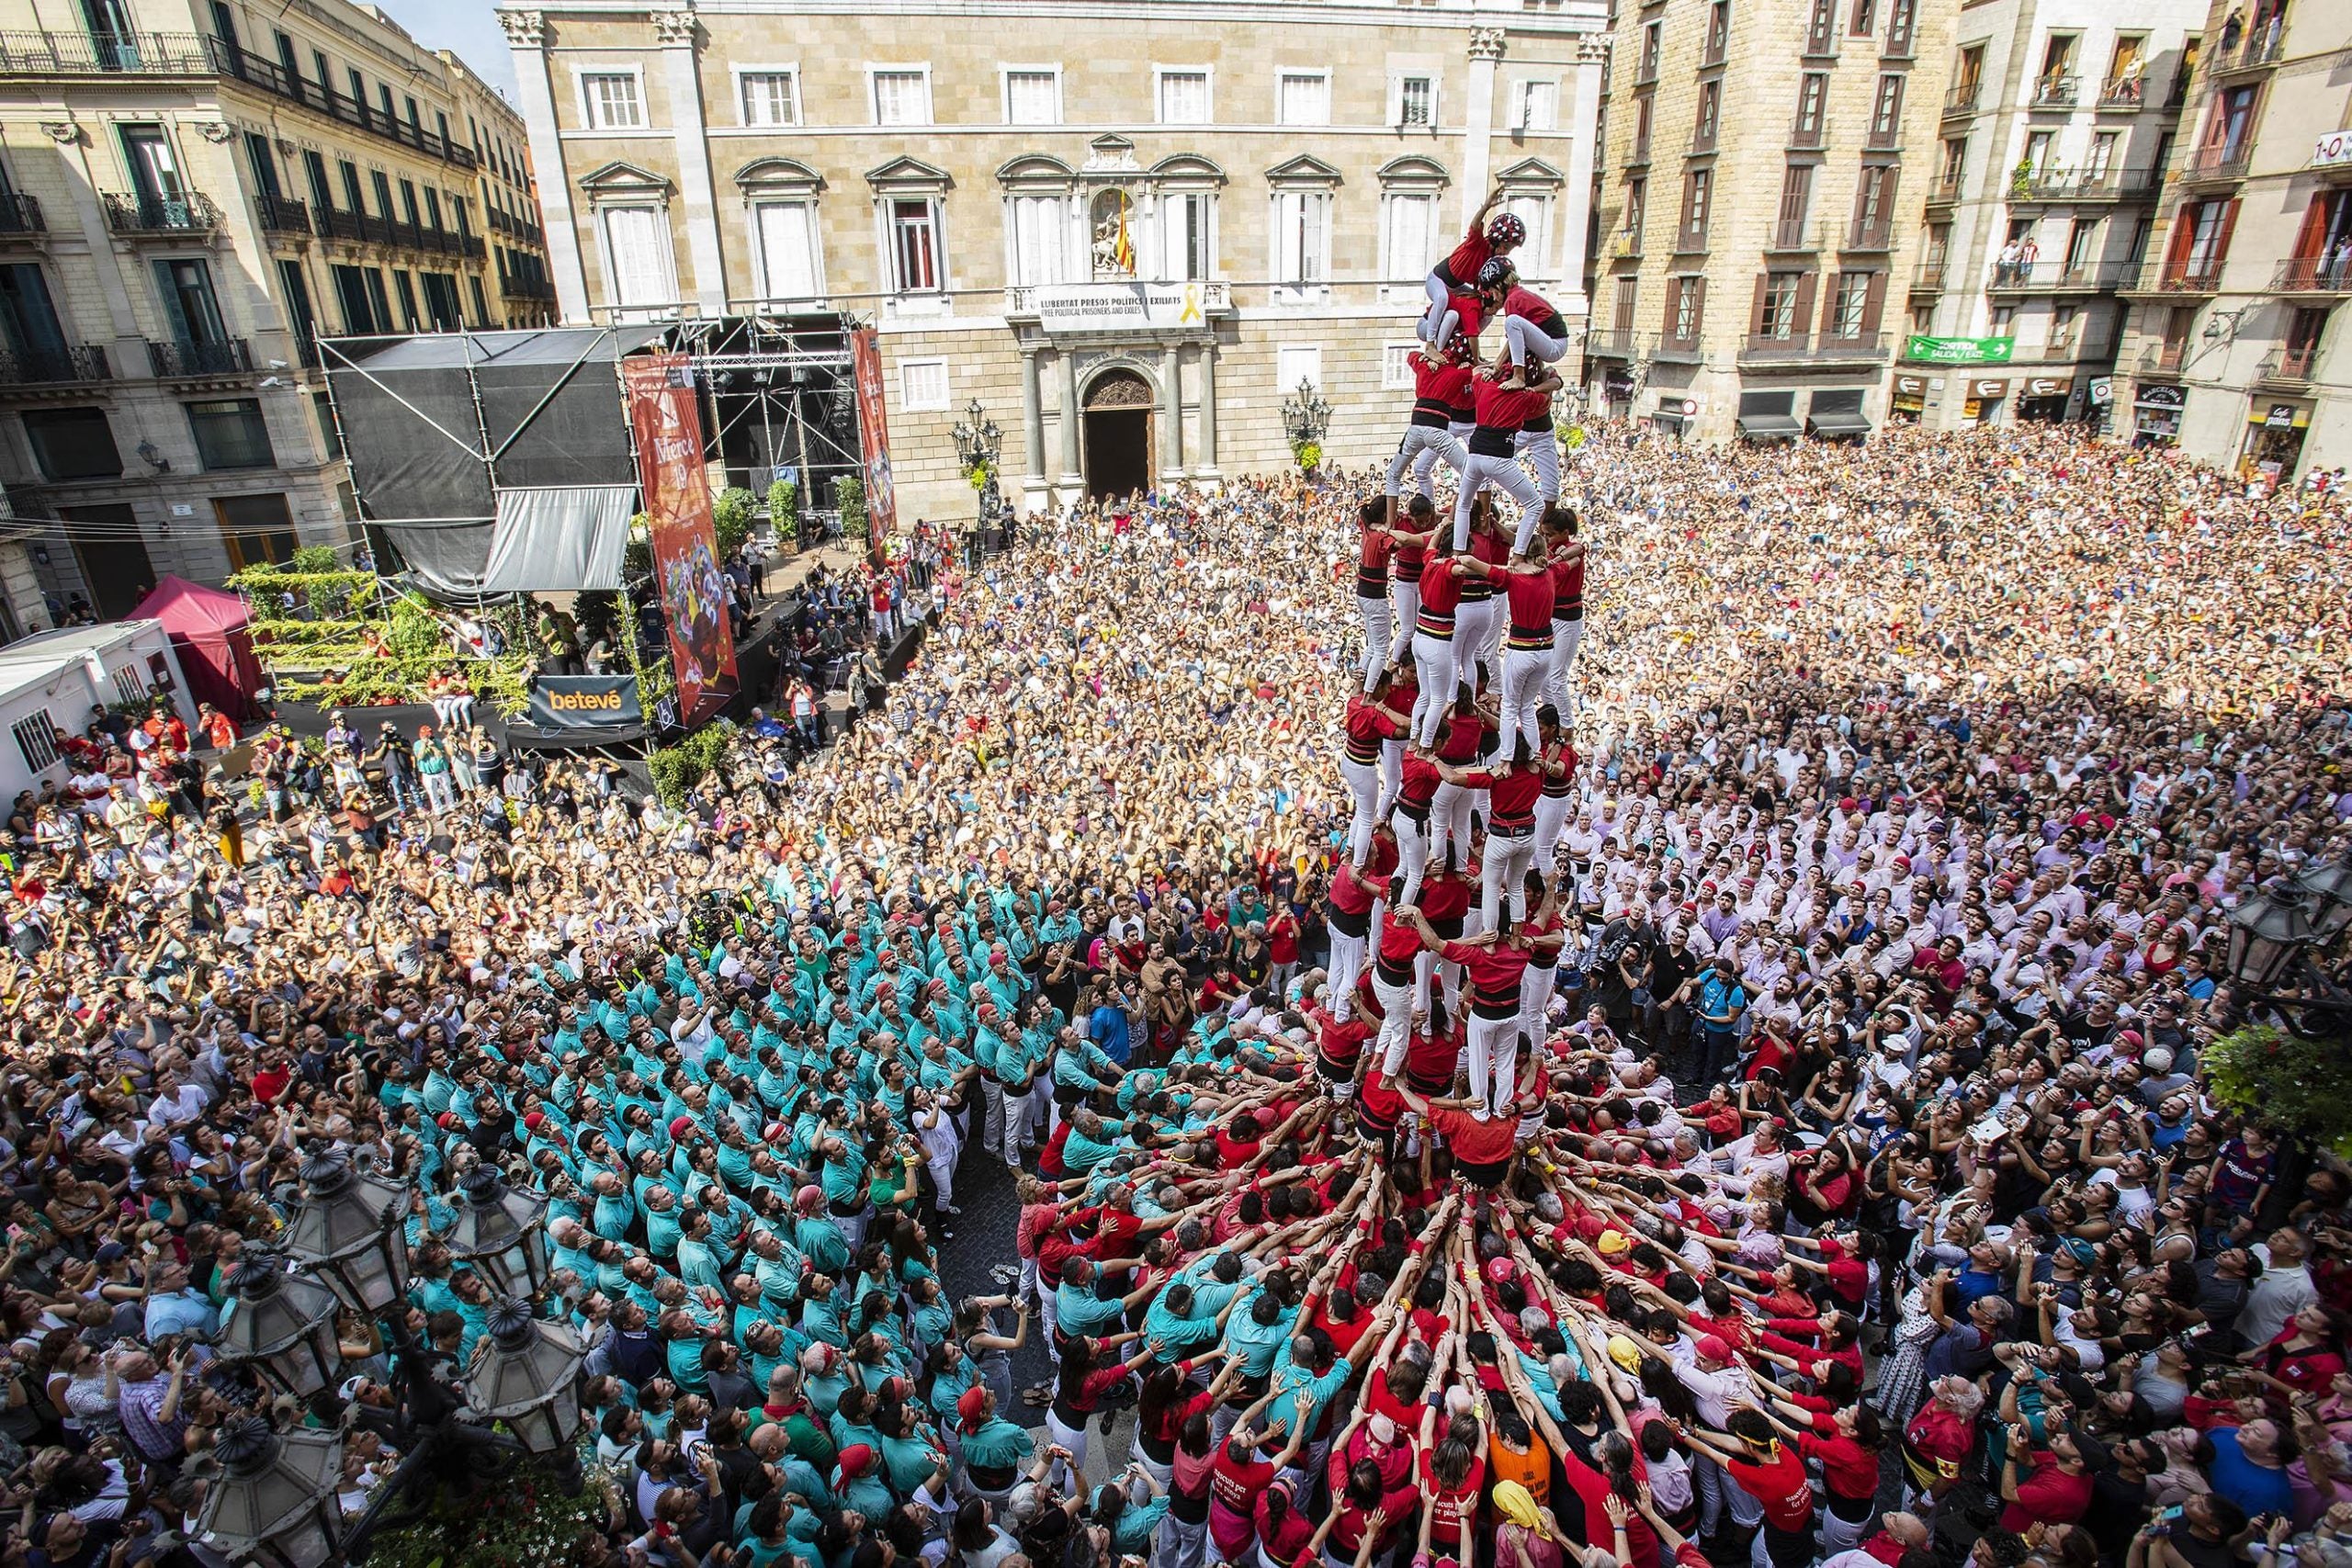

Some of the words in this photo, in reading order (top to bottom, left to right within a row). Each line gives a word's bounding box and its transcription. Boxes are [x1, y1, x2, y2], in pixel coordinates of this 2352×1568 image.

[1041, 298, 1078, 309] LLIBERTAT
[1080, 298, 1109, 307] PRESOS
[1112, 295, 1143, 306] POLÍTICS
[1150, 296, 1181, 305] EXILIATS
[1041, 309, 1054, 317] FREE
[1055, 308, 1080, 317] POLITICAL
[1081, 307, 1111, 315] PRISONERS
[1112, 306, 1124, 314] AND
[1125, 305, 1141, 314] EXILES
[2142, 386, 2181, 403] BARCELONA
[2265, 416, 2291, 427] pans
[653, 429, 695, 465] Mercè
[673, 462, 687, 491] 19
[548, 690, 622, 711] betevé
[2225, 1160, 2258, 1182] Rakuten
[1224, 1484, 1241, 1500] pinya
[1235, 1483, 1247, 1494] per
